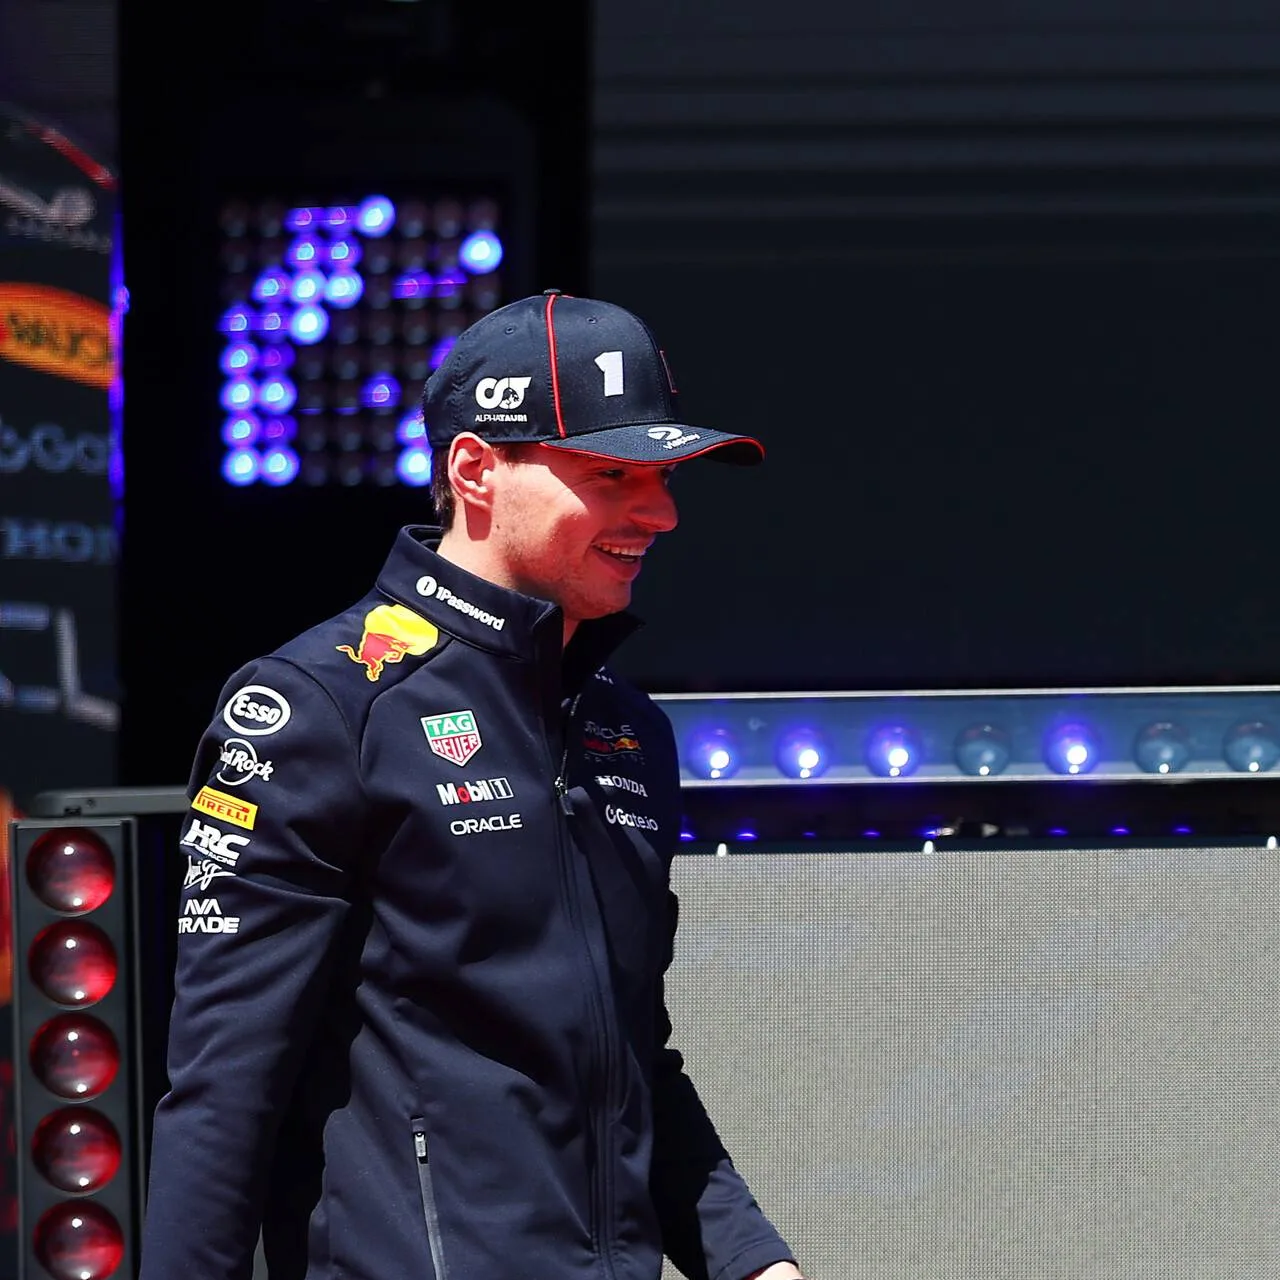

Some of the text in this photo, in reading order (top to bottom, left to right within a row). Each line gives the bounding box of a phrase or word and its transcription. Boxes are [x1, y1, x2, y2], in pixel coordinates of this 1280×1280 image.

[594, 351, 624, 397] 1
[474, 413, 528, 423] ALPHATAURI
[436, 586, 506, 631] 1Password
[426, 716, 473, 736] TAG
[431, 733, 479, 762] HEUER
[230, 748, 274, 781] Rock
[436, 779, 493, 806] Mobil
[594, 775, 649, 798] HONDA
[196, 790, 250, 823] PIRELLI
[449, 813, 524, 836] ORACLE
[183, 819, 251, 860] HRC
